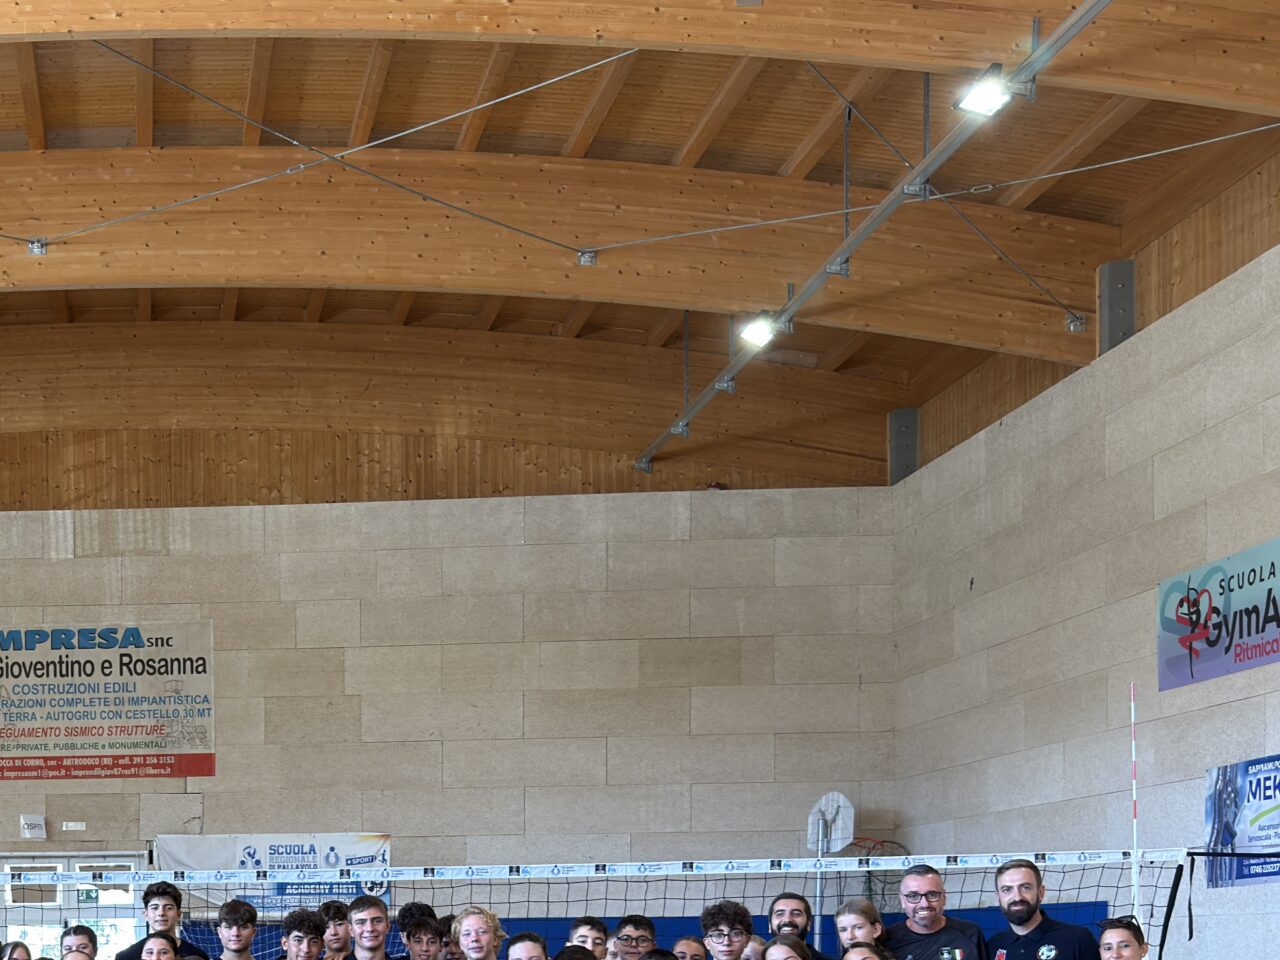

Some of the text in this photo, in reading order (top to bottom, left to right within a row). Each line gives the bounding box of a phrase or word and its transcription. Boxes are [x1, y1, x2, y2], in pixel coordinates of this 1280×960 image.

[1219, 561, 1276, 596] SCUOLA
[146, 636, 173, 648] snc
[101, 660, 113, 677] e
[119, 653, 207, 677] Rosanna
[12, 682, 137, 696] COSTRUZIONI EDILI
[49, 697, 111, 709] COMPLETE
[114, 697, 125, 707] DI
[128, 695, 210, 707] IMPIANTISTICA
[2, 711, 37, 722] TERRA
[46, 710, 96, 721] AUTOGRU
[100, 710, 122, 720] CON
[125, 708, 180, 720] CESTELLO
[183, 708, 194, 718] 30
[197, 708, 212, 718] MT
[63, 725, 104, 737] SISMICO
[107, 724, 166, 737] STRUTTURE
[53, 742, 99, 751] PUBBLICHE
[108, 740, 167, 750] MONUMENTALI
[269, 844, 317, 855] SCUOLA
[269, 855, 318, 864] REGIONALE
[286, 884, 356, 893] ACADEMY RIETI
